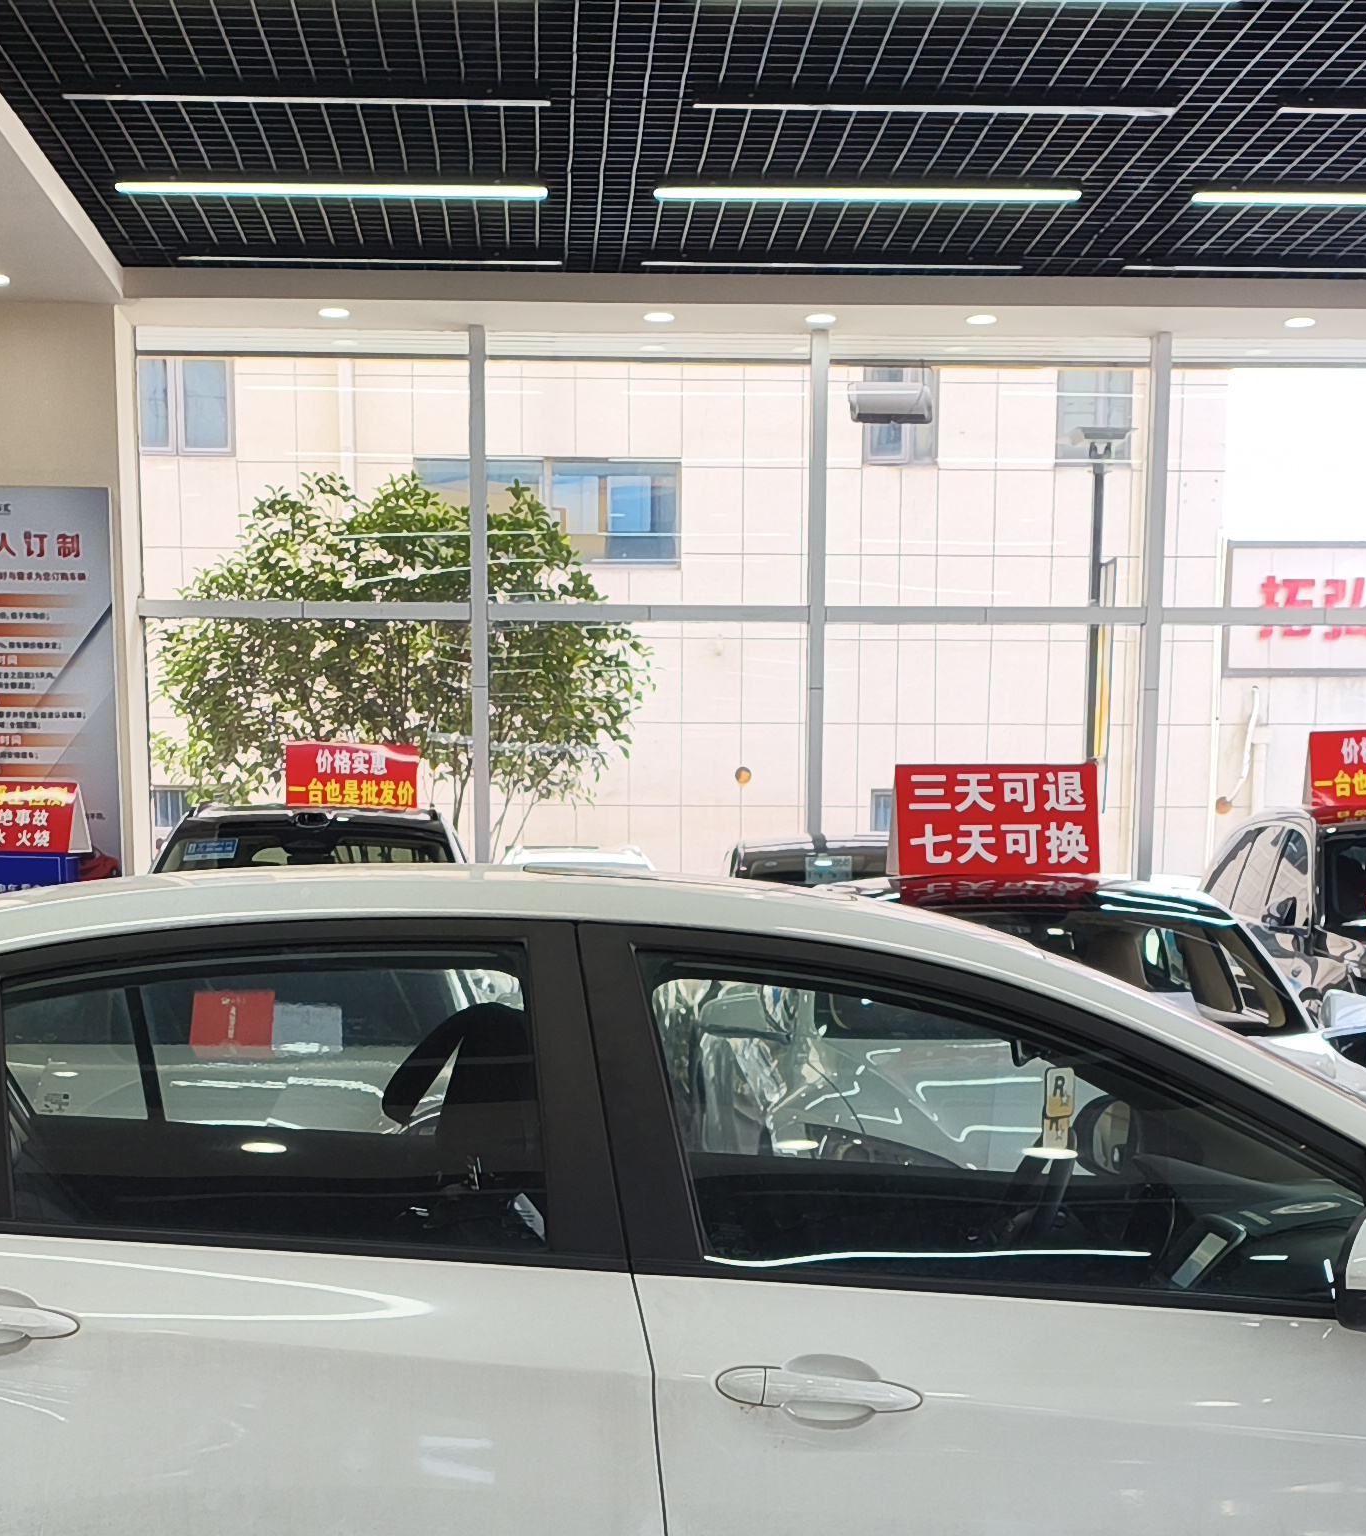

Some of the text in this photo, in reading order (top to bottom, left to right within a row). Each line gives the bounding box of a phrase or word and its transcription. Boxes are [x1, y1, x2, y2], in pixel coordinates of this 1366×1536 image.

[316, 749, 387, 775] 价格实惠
[288, 778, 415, 805] 一台也是批发价
[908, 771, 1087, 813] 三天可退
[15, 830, 51, 847] 火烧
[909, 821, 1089, 865] 七天可换
